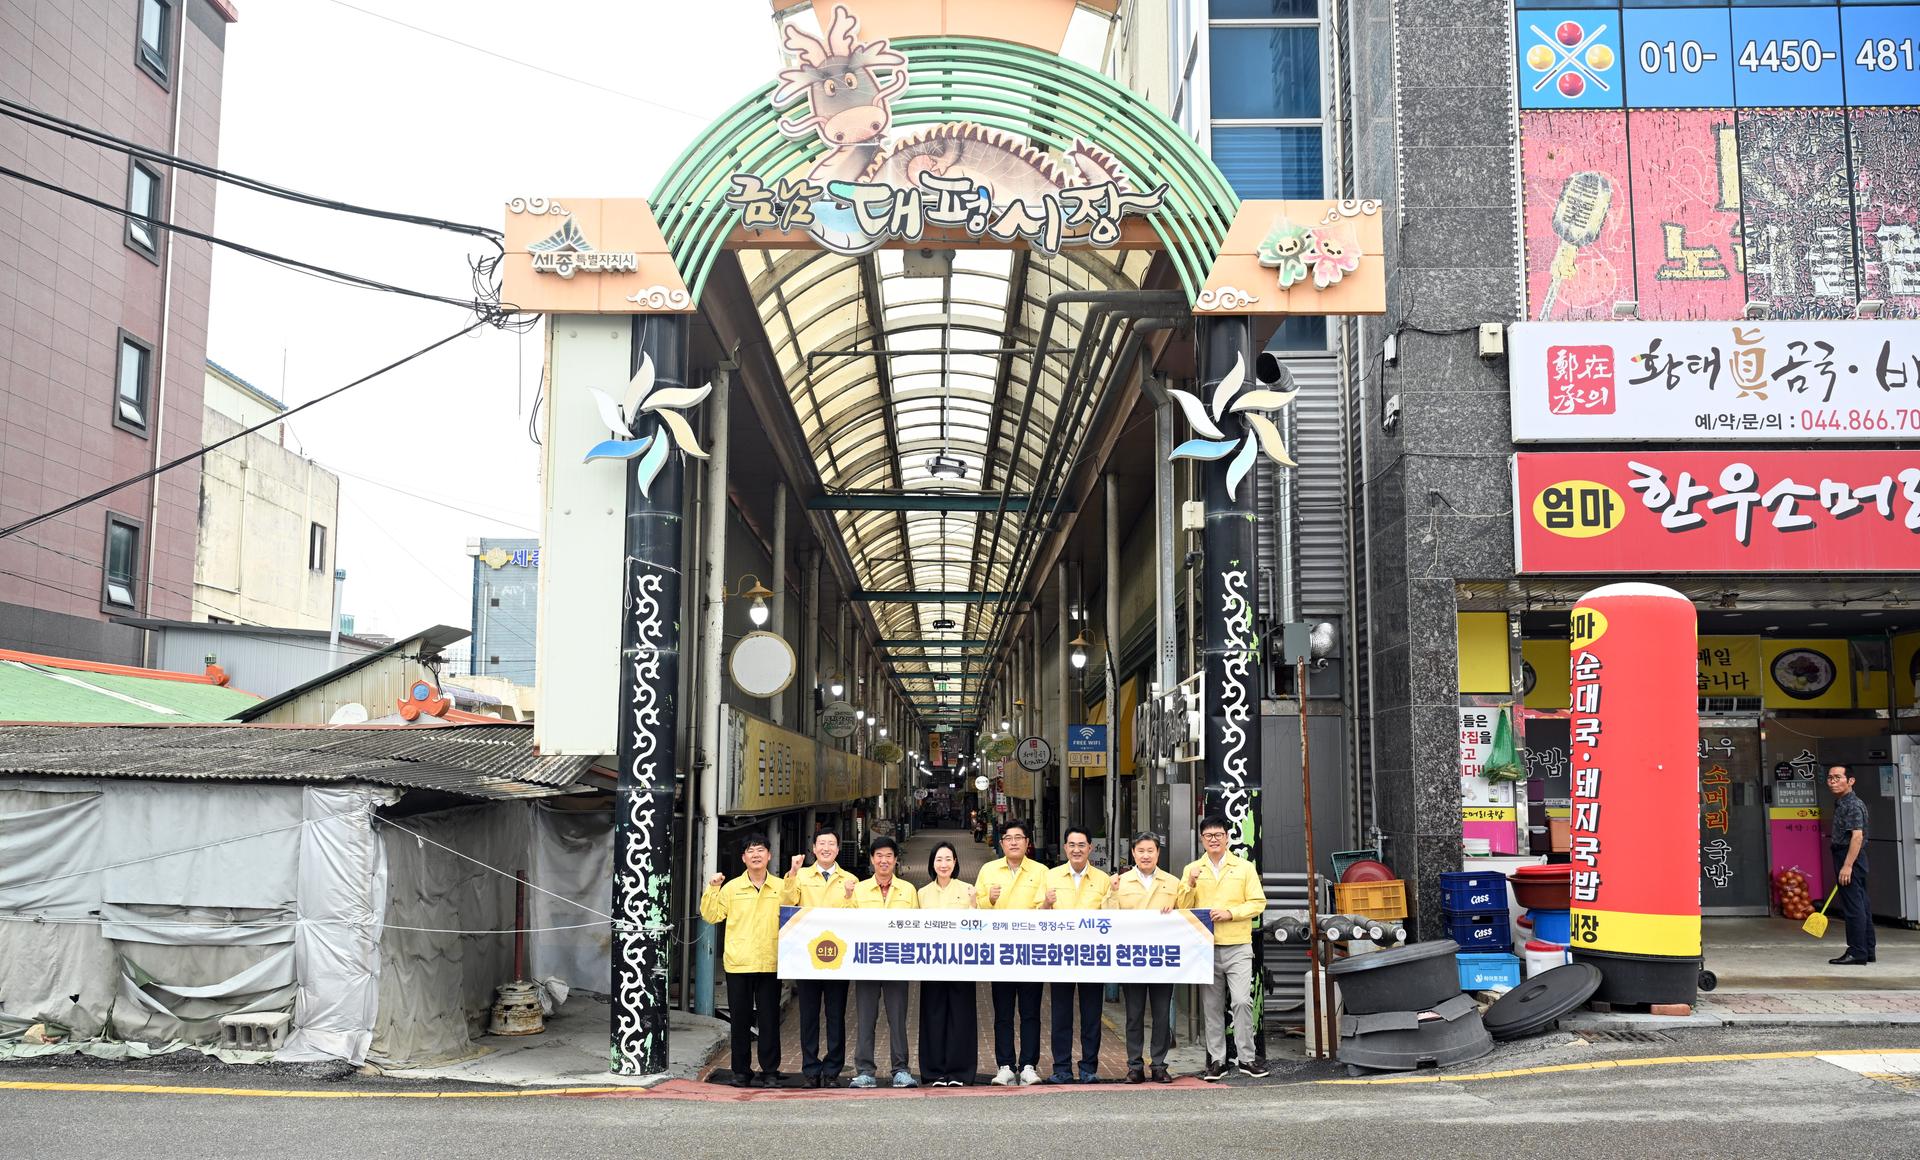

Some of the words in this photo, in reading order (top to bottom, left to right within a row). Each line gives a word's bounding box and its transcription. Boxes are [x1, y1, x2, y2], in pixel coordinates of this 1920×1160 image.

[1640, 40, 1718, 73] 010-
[1738, 39, 1837, 72] 4450-
[1855, 38, 1920, 71] 481
[1543, 487, 1614, 529] 엄마
[1460, 714, 1488, 728] 들은
[1703, 764, 1731, 834] 소머리
[1704, 839, 1734, 888] 국밥
[1471, 893, 1489, 905] Cass
[888, 920, 920, 929] 소통으로
[924, 920, 957, 929] 신뢰받는
[961, 919, 983, 931] 의회
[992, 922, 1009, 931] 함께
[1012, 922, 1036, 931] 만드는
[1039, 920, 1076, 931] 행정수도
[1078, 918, 1112, 935] 세종
[1474, 927, 1493, 940] Cass
[817, 946, 837, 957] 의회
[853, 942, 995, 965] 세종특별자치시의회
[1000, 943, 1112, 966] 경제문화위원회
[1116, 944, 1181, 967] 현장방문
